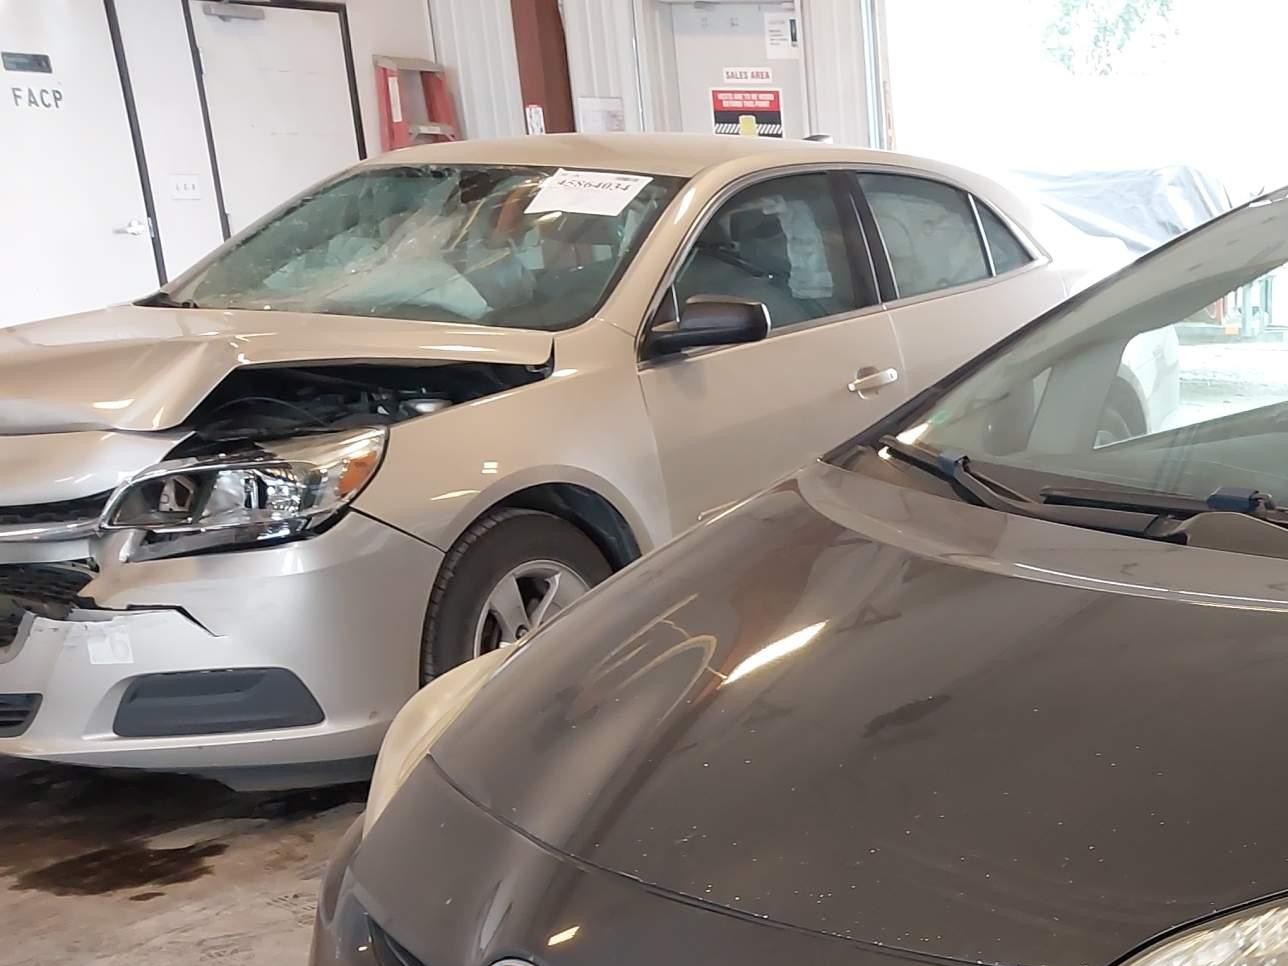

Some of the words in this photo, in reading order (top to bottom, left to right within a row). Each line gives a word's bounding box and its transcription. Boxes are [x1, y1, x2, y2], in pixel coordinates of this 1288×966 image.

[726, 71, 748, 79] SALES
[751, 71, 770, 80] AREA
[11, 87, 63, 108] FACP
